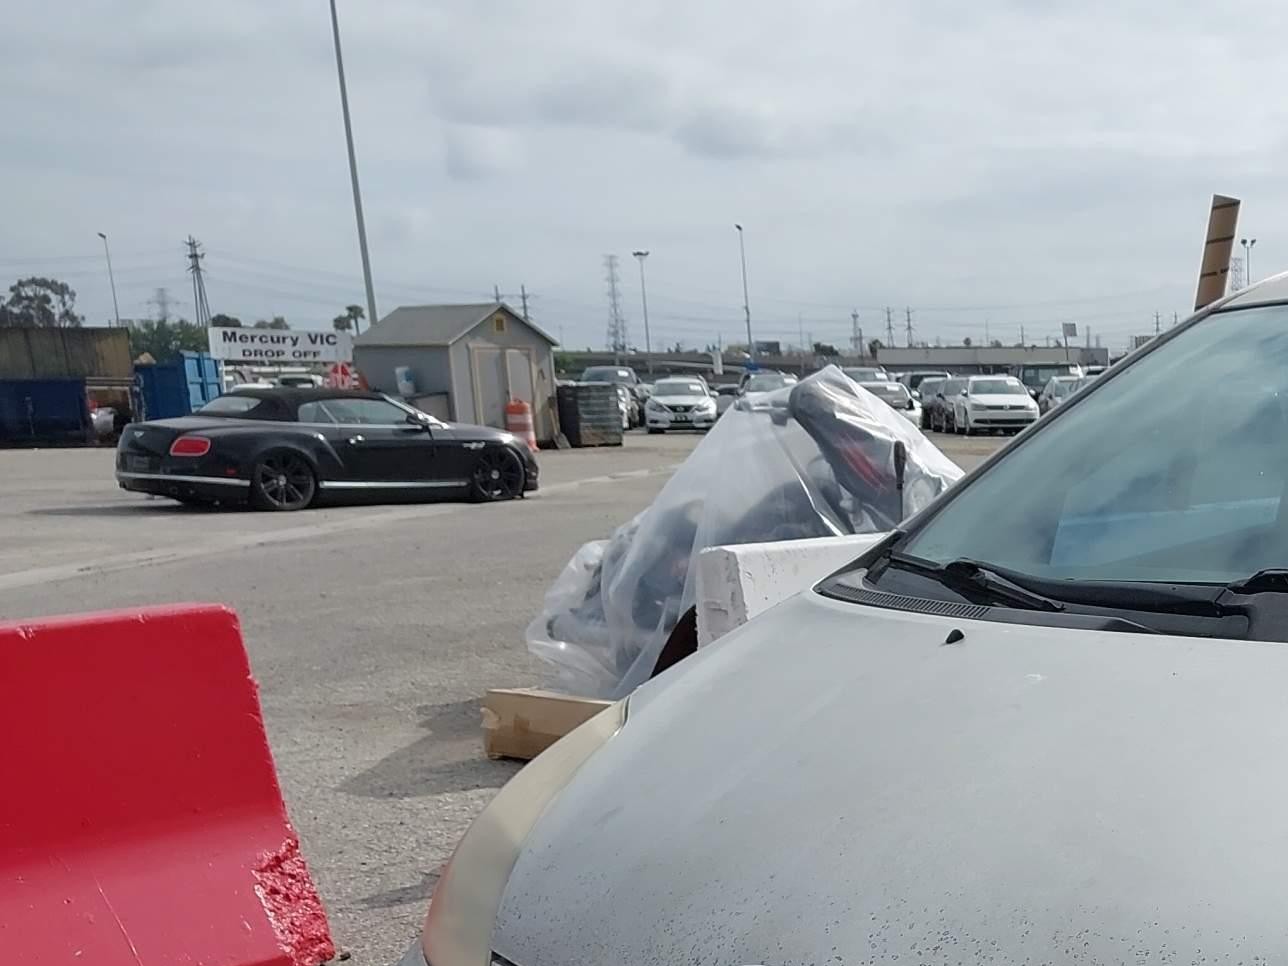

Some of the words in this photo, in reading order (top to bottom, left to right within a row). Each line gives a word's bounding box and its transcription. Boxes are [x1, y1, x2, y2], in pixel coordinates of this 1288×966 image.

[222, 331, 299, 347] Mercury
[308, 333, 338, 346] VIC
[242, 349, 285, 358] DROP
[292, 350, 321, 358] OFF
